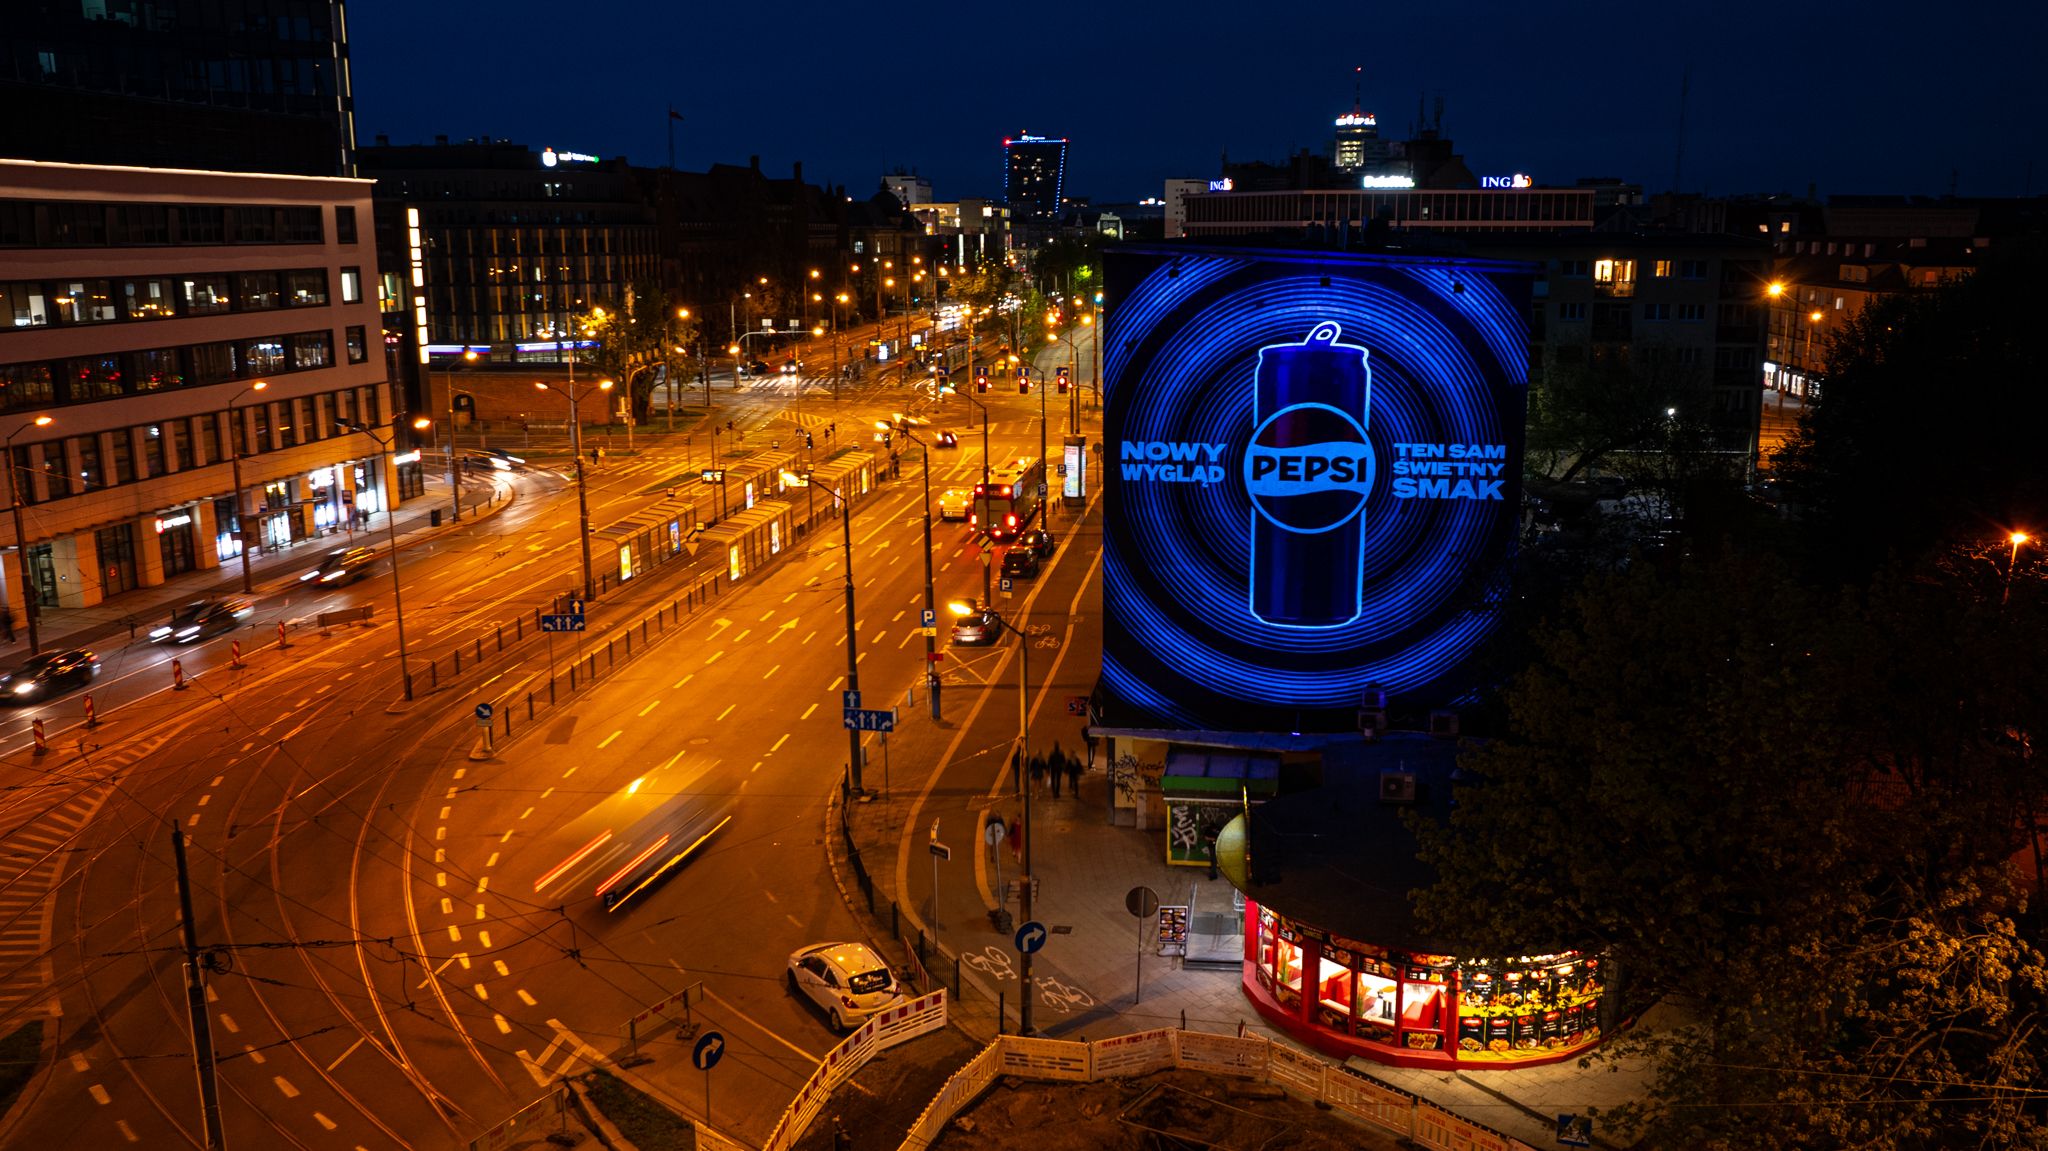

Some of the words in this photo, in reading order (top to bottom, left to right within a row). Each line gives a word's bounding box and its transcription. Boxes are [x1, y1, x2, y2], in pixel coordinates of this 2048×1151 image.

[1210, 180, 1224, 191] ING
[1482, 176, 1511, 188] ING
[1121, 441, 1227, 462] NOWY
[1393, 442, 1445, 458] TEN
[1449, 443, 1505, 459] SAM
[1121, 463, 1226, 488] WYGLĄD
[1252, 455, 1367, 483] PEPSI
[1392, 457, 1505, 476] ŚWIETNY
[1392, 477, 1505, 500] SMAK
[1001, 579, 1010, 590] P
[923, 610, 933, 623] P
